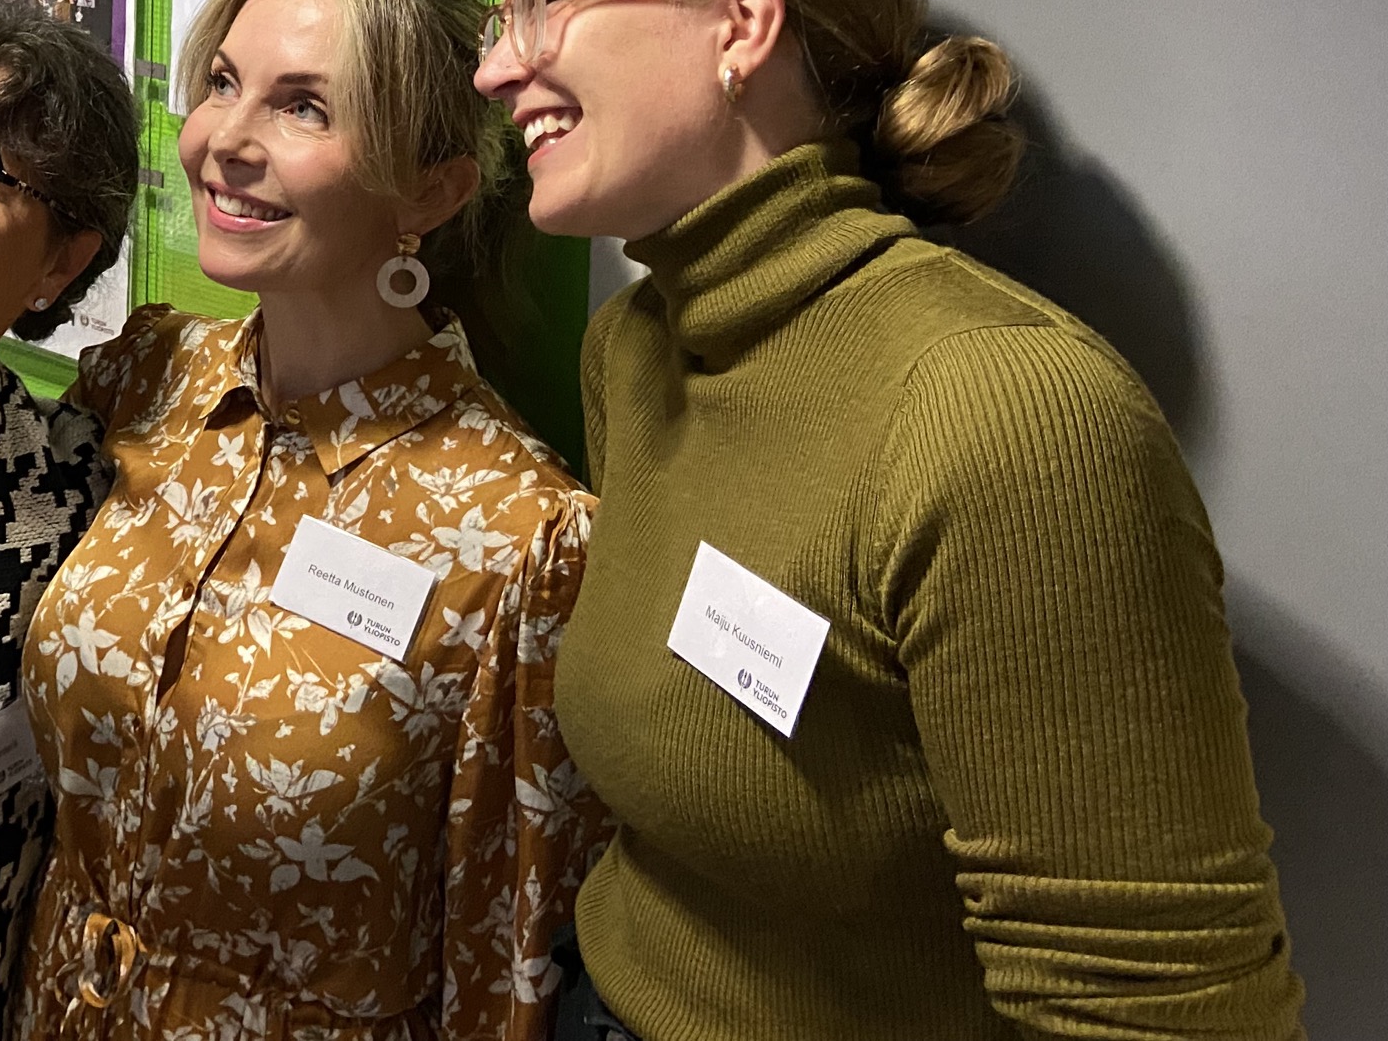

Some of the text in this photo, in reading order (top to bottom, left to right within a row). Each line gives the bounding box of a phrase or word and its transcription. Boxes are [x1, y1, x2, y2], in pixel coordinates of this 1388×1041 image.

[308, 564, 395, 610] Reetta Mustonen
[363, 625, 401, 647] YLIOPISTO
[366, 618, 392, 634] TURUN
[705, 605, 783, 669] Maiju Kuusniemi
[755, 680, 780, 701] TURUN
[752, 689, 787, 719] YLIOPISTO
